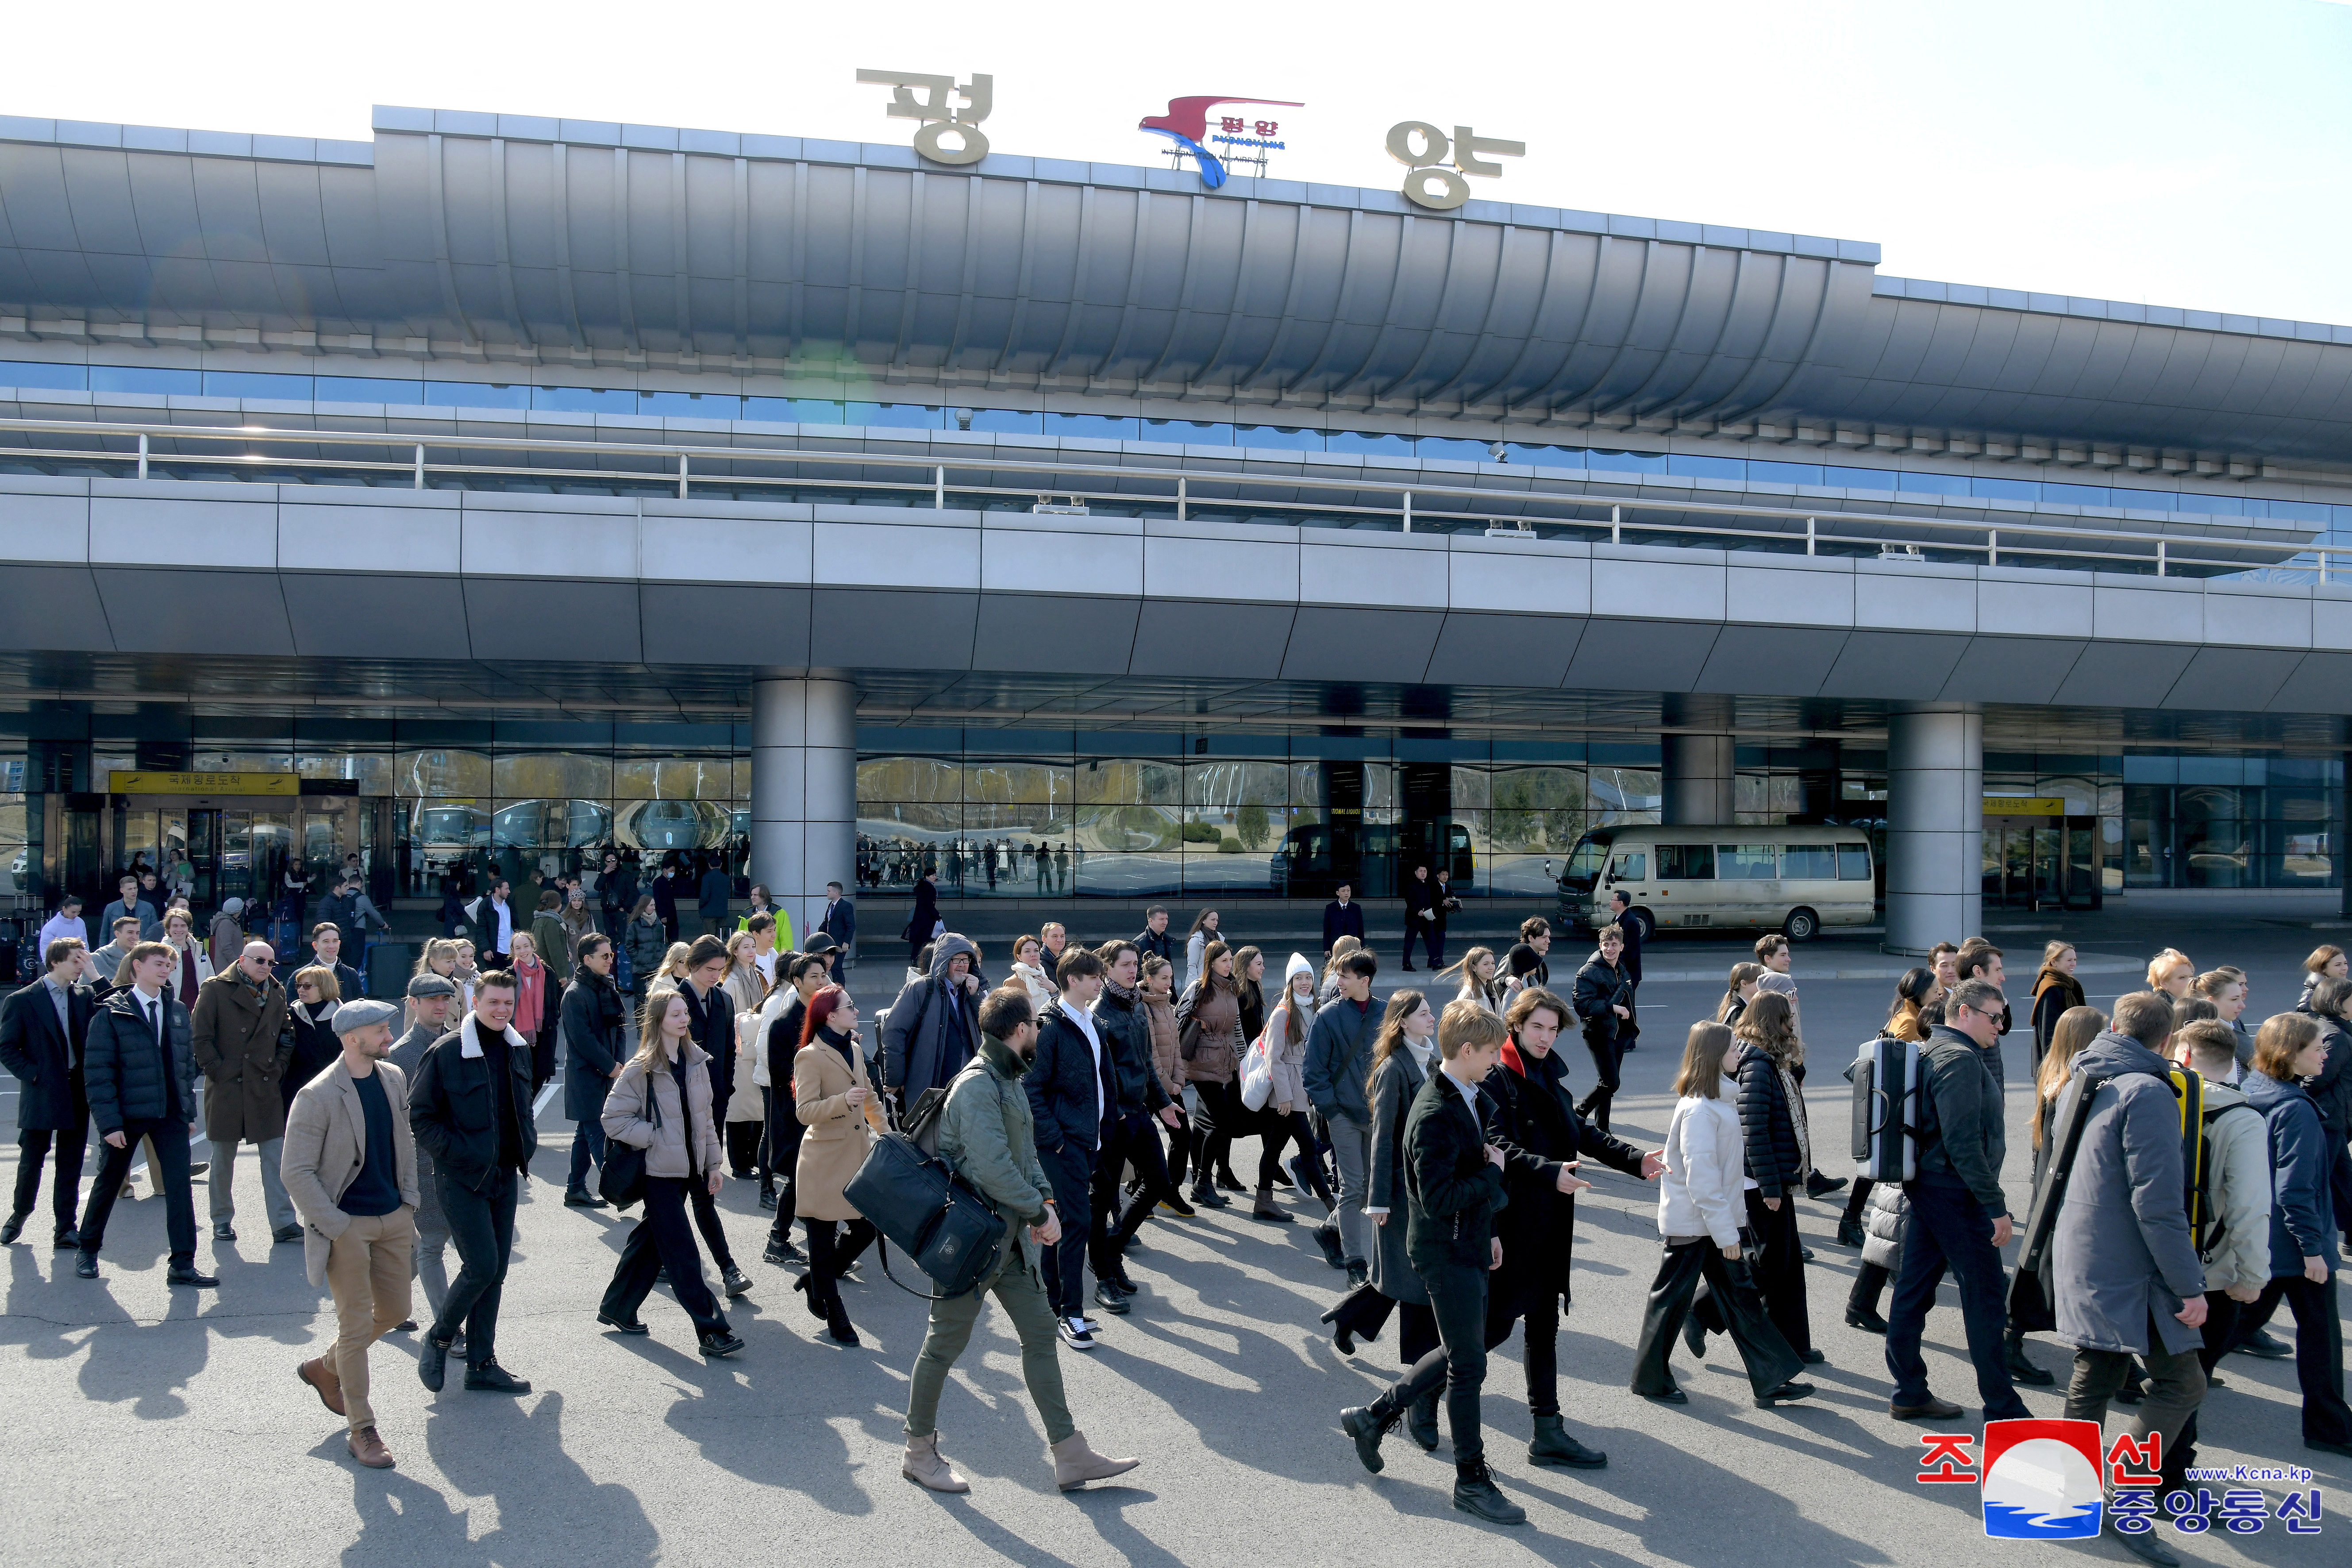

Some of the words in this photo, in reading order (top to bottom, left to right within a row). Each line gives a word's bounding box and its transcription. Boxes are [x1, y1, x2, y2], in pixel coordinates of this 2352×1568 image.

[856, 68, 993, 165] 평
[1212, 135, 1286, 150] PYONGYANG
[1161, 149, 1230, 162] INTERNATIONAL
[1234, 156, 1270, 165] AIRPORT
[1385, 121, 1525, 210] 양
[168, 774, 241, 785] 국제항로도착
